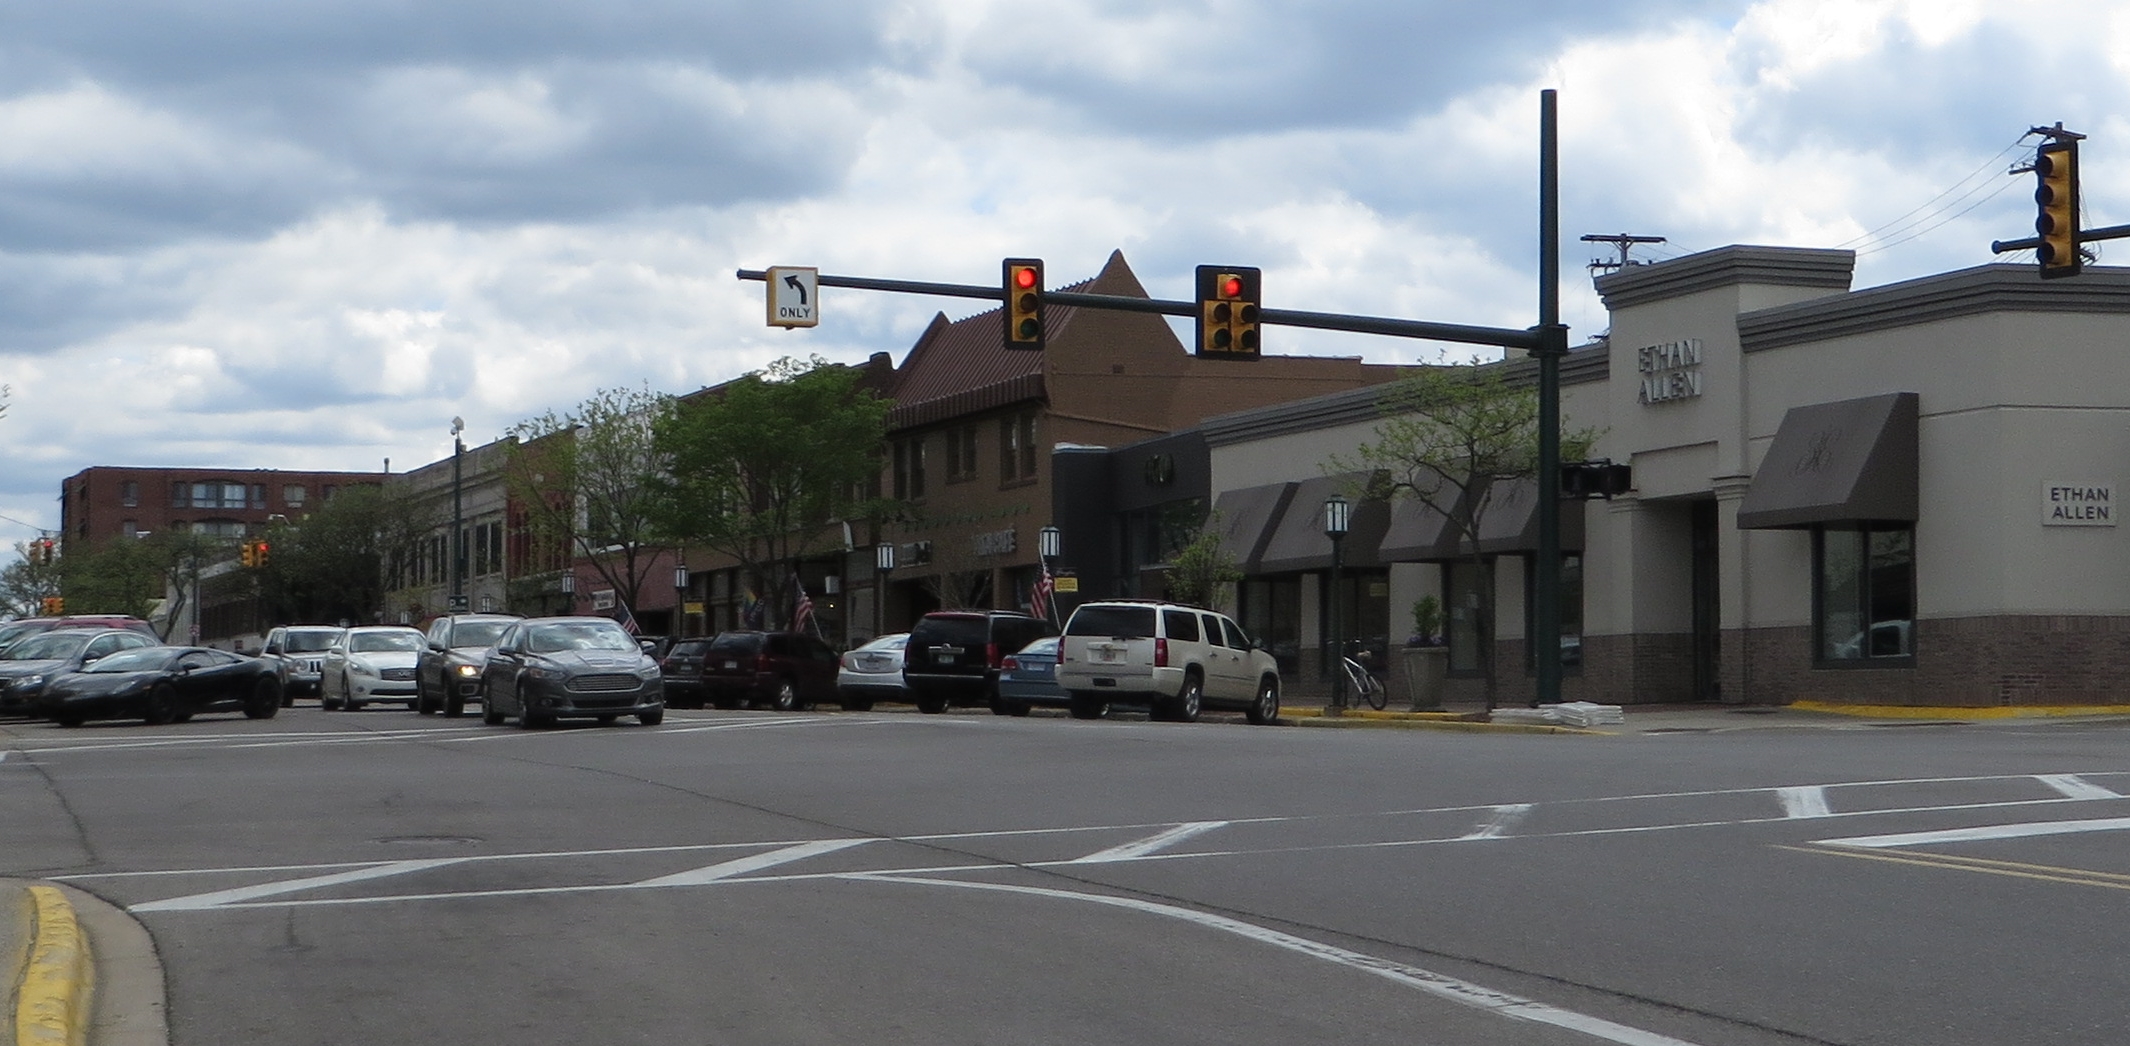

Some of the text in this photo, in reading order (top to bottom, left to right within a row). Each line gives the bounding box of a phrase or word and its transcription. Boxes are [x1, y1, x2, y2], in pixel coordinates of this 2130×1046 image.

[780, 307, 811, 319] ONLY
[1638, 338, 1702, 373] ETHAN
[1637, 372, 1702, 405] ALLEN
[2051, 487, 2109, 502] ETHAN
[2051, 505, 2109, 520] ALLEN
